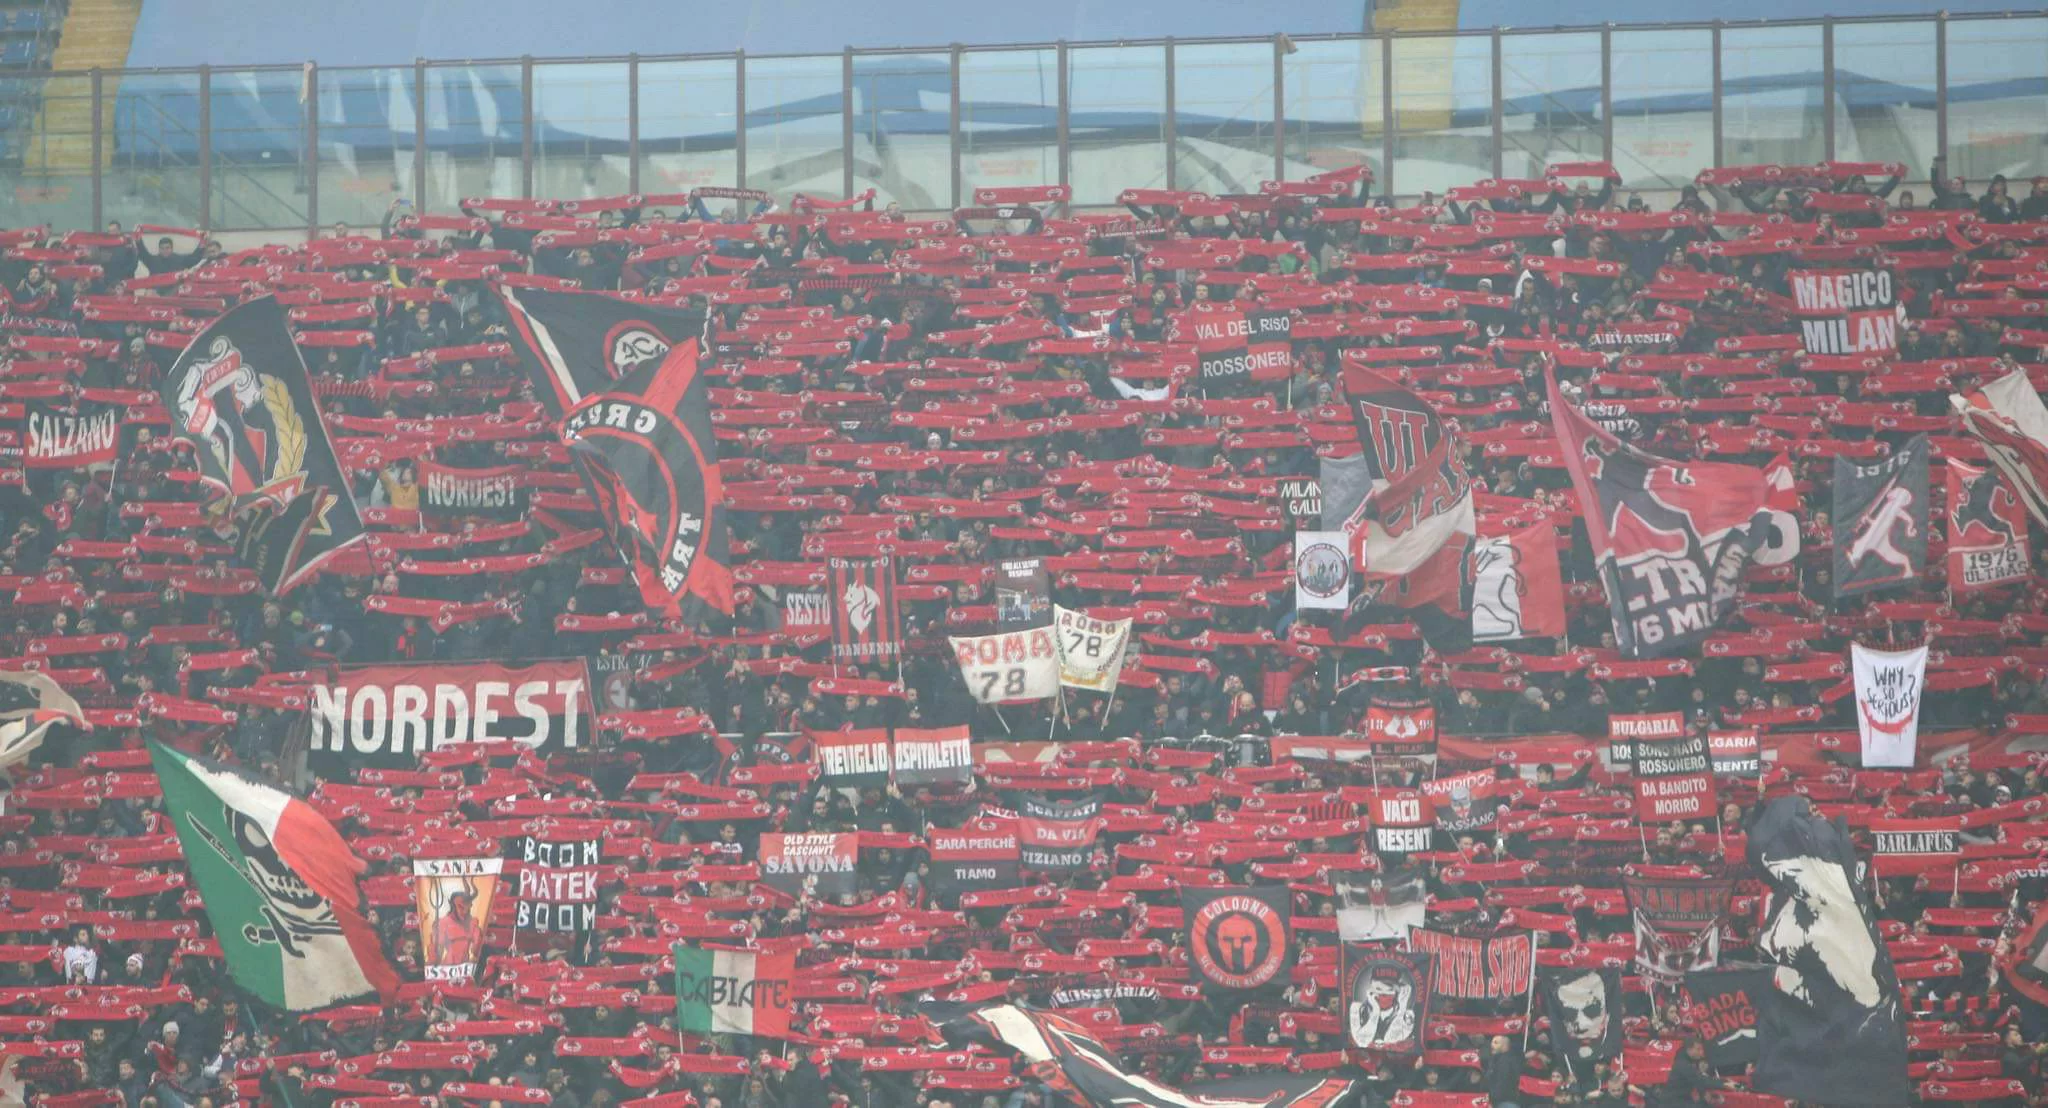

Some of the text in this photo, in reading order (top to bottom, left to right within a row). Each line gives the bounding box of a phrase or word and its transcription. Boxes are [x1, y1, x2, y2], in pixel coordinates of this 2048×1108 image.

[1794, 270, 1892, 309] MAGICO
[1195, 316, 1290, 339] VAL DEL RISO
[1802, 314, 1897, 354] MILAN
[1203, 351, 1291, 378] ROSSONERI
[28, 410, 115, 457] SALZANO
[428, 471, 514, 507] NORDEST
[1969, 547, 2019, 570] 1976
[1966, 561, 2030, 583] ULTRAS
[786, 592, 831, 625] SESTO
[1061, 611, 1117, 635] ROMA
[958, 629, 1053, 667] ROMA
[1066, 629, 1102, 658] '78
[1873, 665, 1904, 687] WHY
[1882, 687, 1896, 700] SO
[310, 680, 584, 754] NORDEST
[1612, 718, 1679, 736] BULGARIA
[895, 738, 970, 770] OSPITALETTO
[1639, 755, 1706, 775] ROSSONERO
[1642, 777, 1708, 797] DA BANDITO
[783, 834, 836, 845] OLD STYLE
[1037, 827, 1087, 841] DA VIA
[1876, 829, 1953, 854] BARLAFÜS
[524, 836, 599, 867] BOOM
[783, 845, 836, 856] CASCIAVIT
[1022, 851, 1081, 865] TIZIANO
[430, 860, 484, 874] SANTA
[766, 854, 855, 874] SAVONA
[955, 867, 996, 880] TI AMO
[519, 868, 598, 900] PIATEK
[517, 901, 596, 931] BOOM
[1203, 896, 1269, 920] COLOGNO
[1487, 934, 1530, 998] SUD
[680, 971, 788, 1009] CABIATE
[1692, 990, 1749, 1021] BADA
[1700, 1007, 1756, 1041] BING
